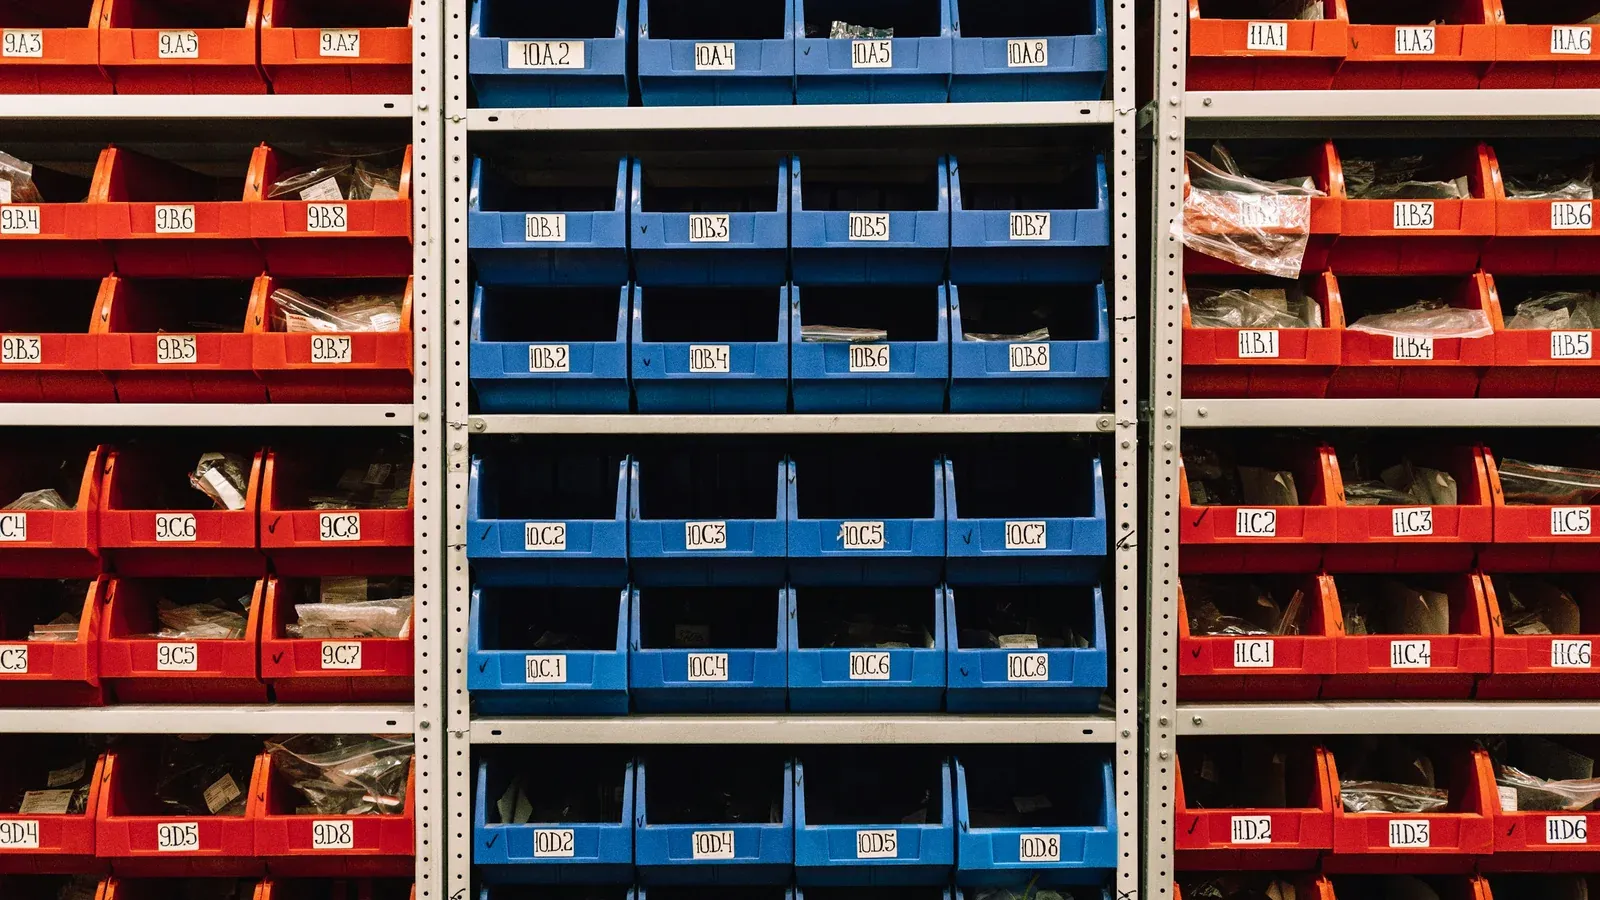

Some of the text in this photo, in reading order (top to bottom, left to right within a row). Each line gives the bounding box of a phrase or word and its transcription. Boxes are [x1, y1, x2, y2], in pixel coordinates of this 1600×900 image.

[4, 33, 41, 52] 9.A.3
[160, 33, 197, 54] 9.A.5
[322, 33, 358, 52] 9.A.7
[1250, 25, 1284, 46] 11.A.1
[1397, 29, 1433, 51] 11.A.3
[1553, 29, 1590, 50] 11.A.6
[523, 42, 570, 66] 10.A.2
[696, 44, 733, 66] 10.A.4
[852, 41, 891, 64] 10.A.5
[1009, 42, 1045, 64] 10.A.8
[1, 209, 38, 230] 9.B.4
[157, 208, 193, 230] 9.B.6
[308, 207, 346, 229] 9.B.8
[1010, 214, 1048, 237] 10.B.7
[1396, 203, 1433, 227] 11.B.3
[1552, 203, 1591, 226] 11.B.6
[527, 216, 561, 238] 10.B.1
[690, 217, 728, 239] 10.B.3
[850, 215, 887, 238] 10.B.5
[3, 338, 39, 360] 9.B.3
[158, 338, 195, 360] 9.B.5
[312, 337, 350, 360] 9.B.7
[1240, 331, 1273, 354] 11.B.1
[1552, 333, 1589, 356] 11.B.5
[530, 347, 566, 369] 10.B.2
[690, 347, 727, 370] 10.B.4
[850, 346, 888, 368] 10.B.6
[1011, 345, 1048, 368] 10.B.8
[0, 515, 25, 537] C.4
[156, 516, 195, 538] 9.C.6
[321, 515, 358, 539] 9.C.8
[1238, 511, 1274, 533] 11.C.2
[1395, 510, 1431, 533] 11.C.3
[1553, 509, 1590, 533] 11.C.5
[526, 525, 564, 546] 10.C.2
[687, 524, 725, 546] 10.C.3
[844, 524, 883, 546] 10.C.5
[1006, 523, 1045, 545] 10.C.7
[159, 645, 195, 665] 9.C.5
[322, 645, 360, 665] 9.C.7
[1236, 642, 1270, 663] 11.C.1
[1393, 643, 1429, 665] 11.C.4
[1554, 643, 1590, 665] 11.C.6
[527, 658, 561, 679] 10.C.1
[689, 655, 726, 678] 10.C.4
[851, 654, 889, 676] 10.C.6
[1009, 655, 1047, 678] 10.C.8
[0, 822, 37, 844] 9.D.4
[159, 824, 197, 847] 9.D.5
[314, 823, 351, 845] 9.D.8
[1233, 819, 1270, 841] 11.D.2
[1390, 823, 1428, 844] 11.D.3
[535, 831, 573, 853] 10.D.2
[695, 832, 732, 854] 10.D.4
[858, 832, 896, 853] 10.D.5
[1021, 837, 1058, 858] 10.D.8
